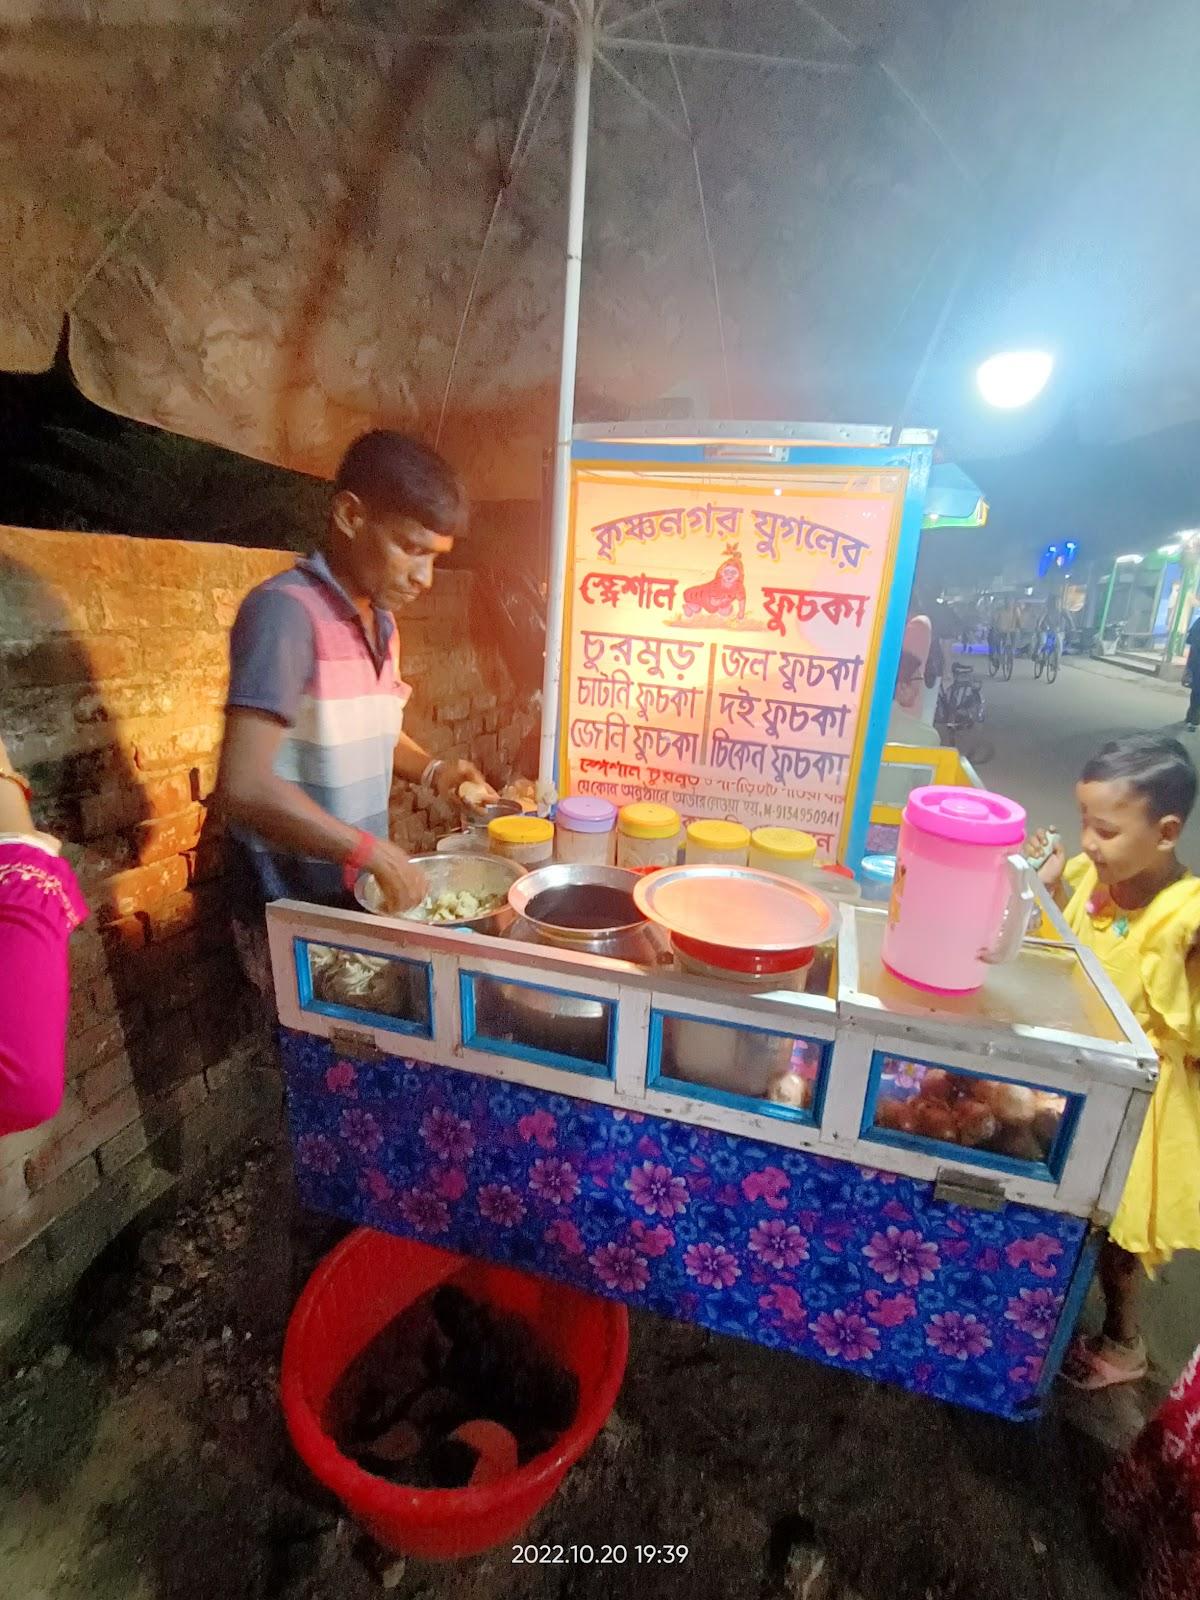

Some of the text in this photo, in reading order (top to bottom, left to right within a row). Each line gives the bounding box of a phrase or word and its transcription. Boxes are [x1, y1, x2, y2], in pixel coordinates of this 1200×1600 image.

[591, 502, 871, 569] কৃষ্ণনগর যুগলের
[761, 587, 870, 637] ফুচকা
[580, 630, 704, 681] চুরমুড়
[721, 645, 864, 693] জল ফুচকা
[577, 668, 704, 722] চাটনি ফুচকা
[718, 685, 852, 739] দই ফুচকা
[633, 725, 699, 764] ফুচকা
[711, 727, 850, 786] চিকেন ফুচকা
